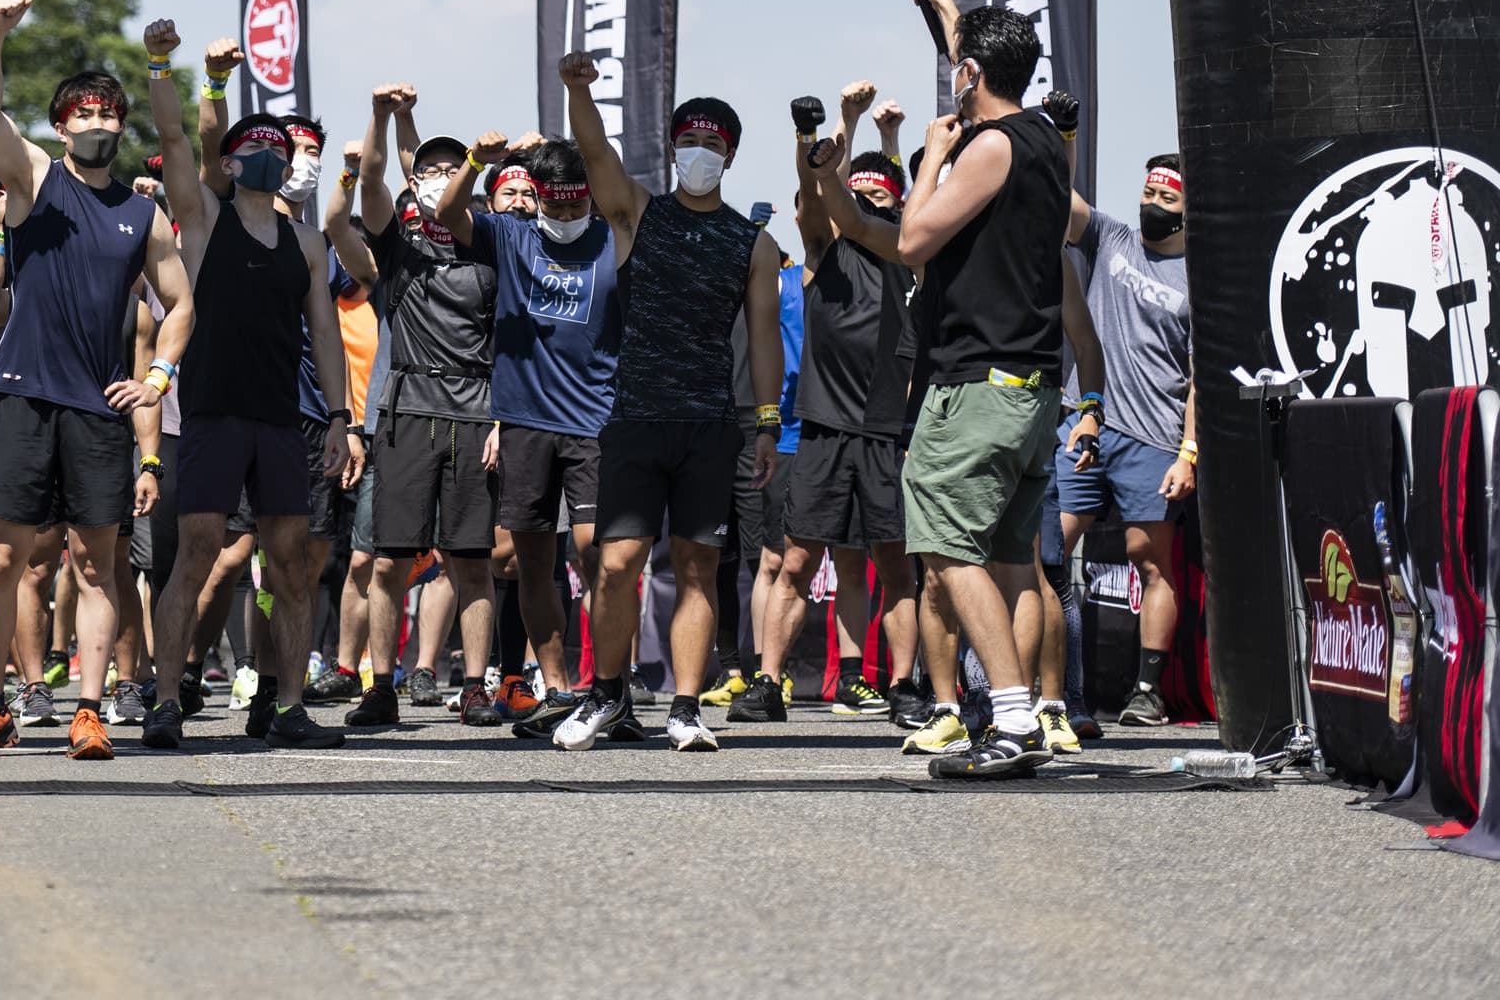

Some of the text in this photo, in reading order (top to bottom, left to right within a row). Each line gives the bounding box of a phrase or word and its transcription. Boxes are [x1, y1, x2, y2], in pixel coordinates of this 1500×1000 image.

[553, 192, 578, 200] 3511
[542, 274, 584, 295] のむ
[540, 293, 579, 317] シリカ
